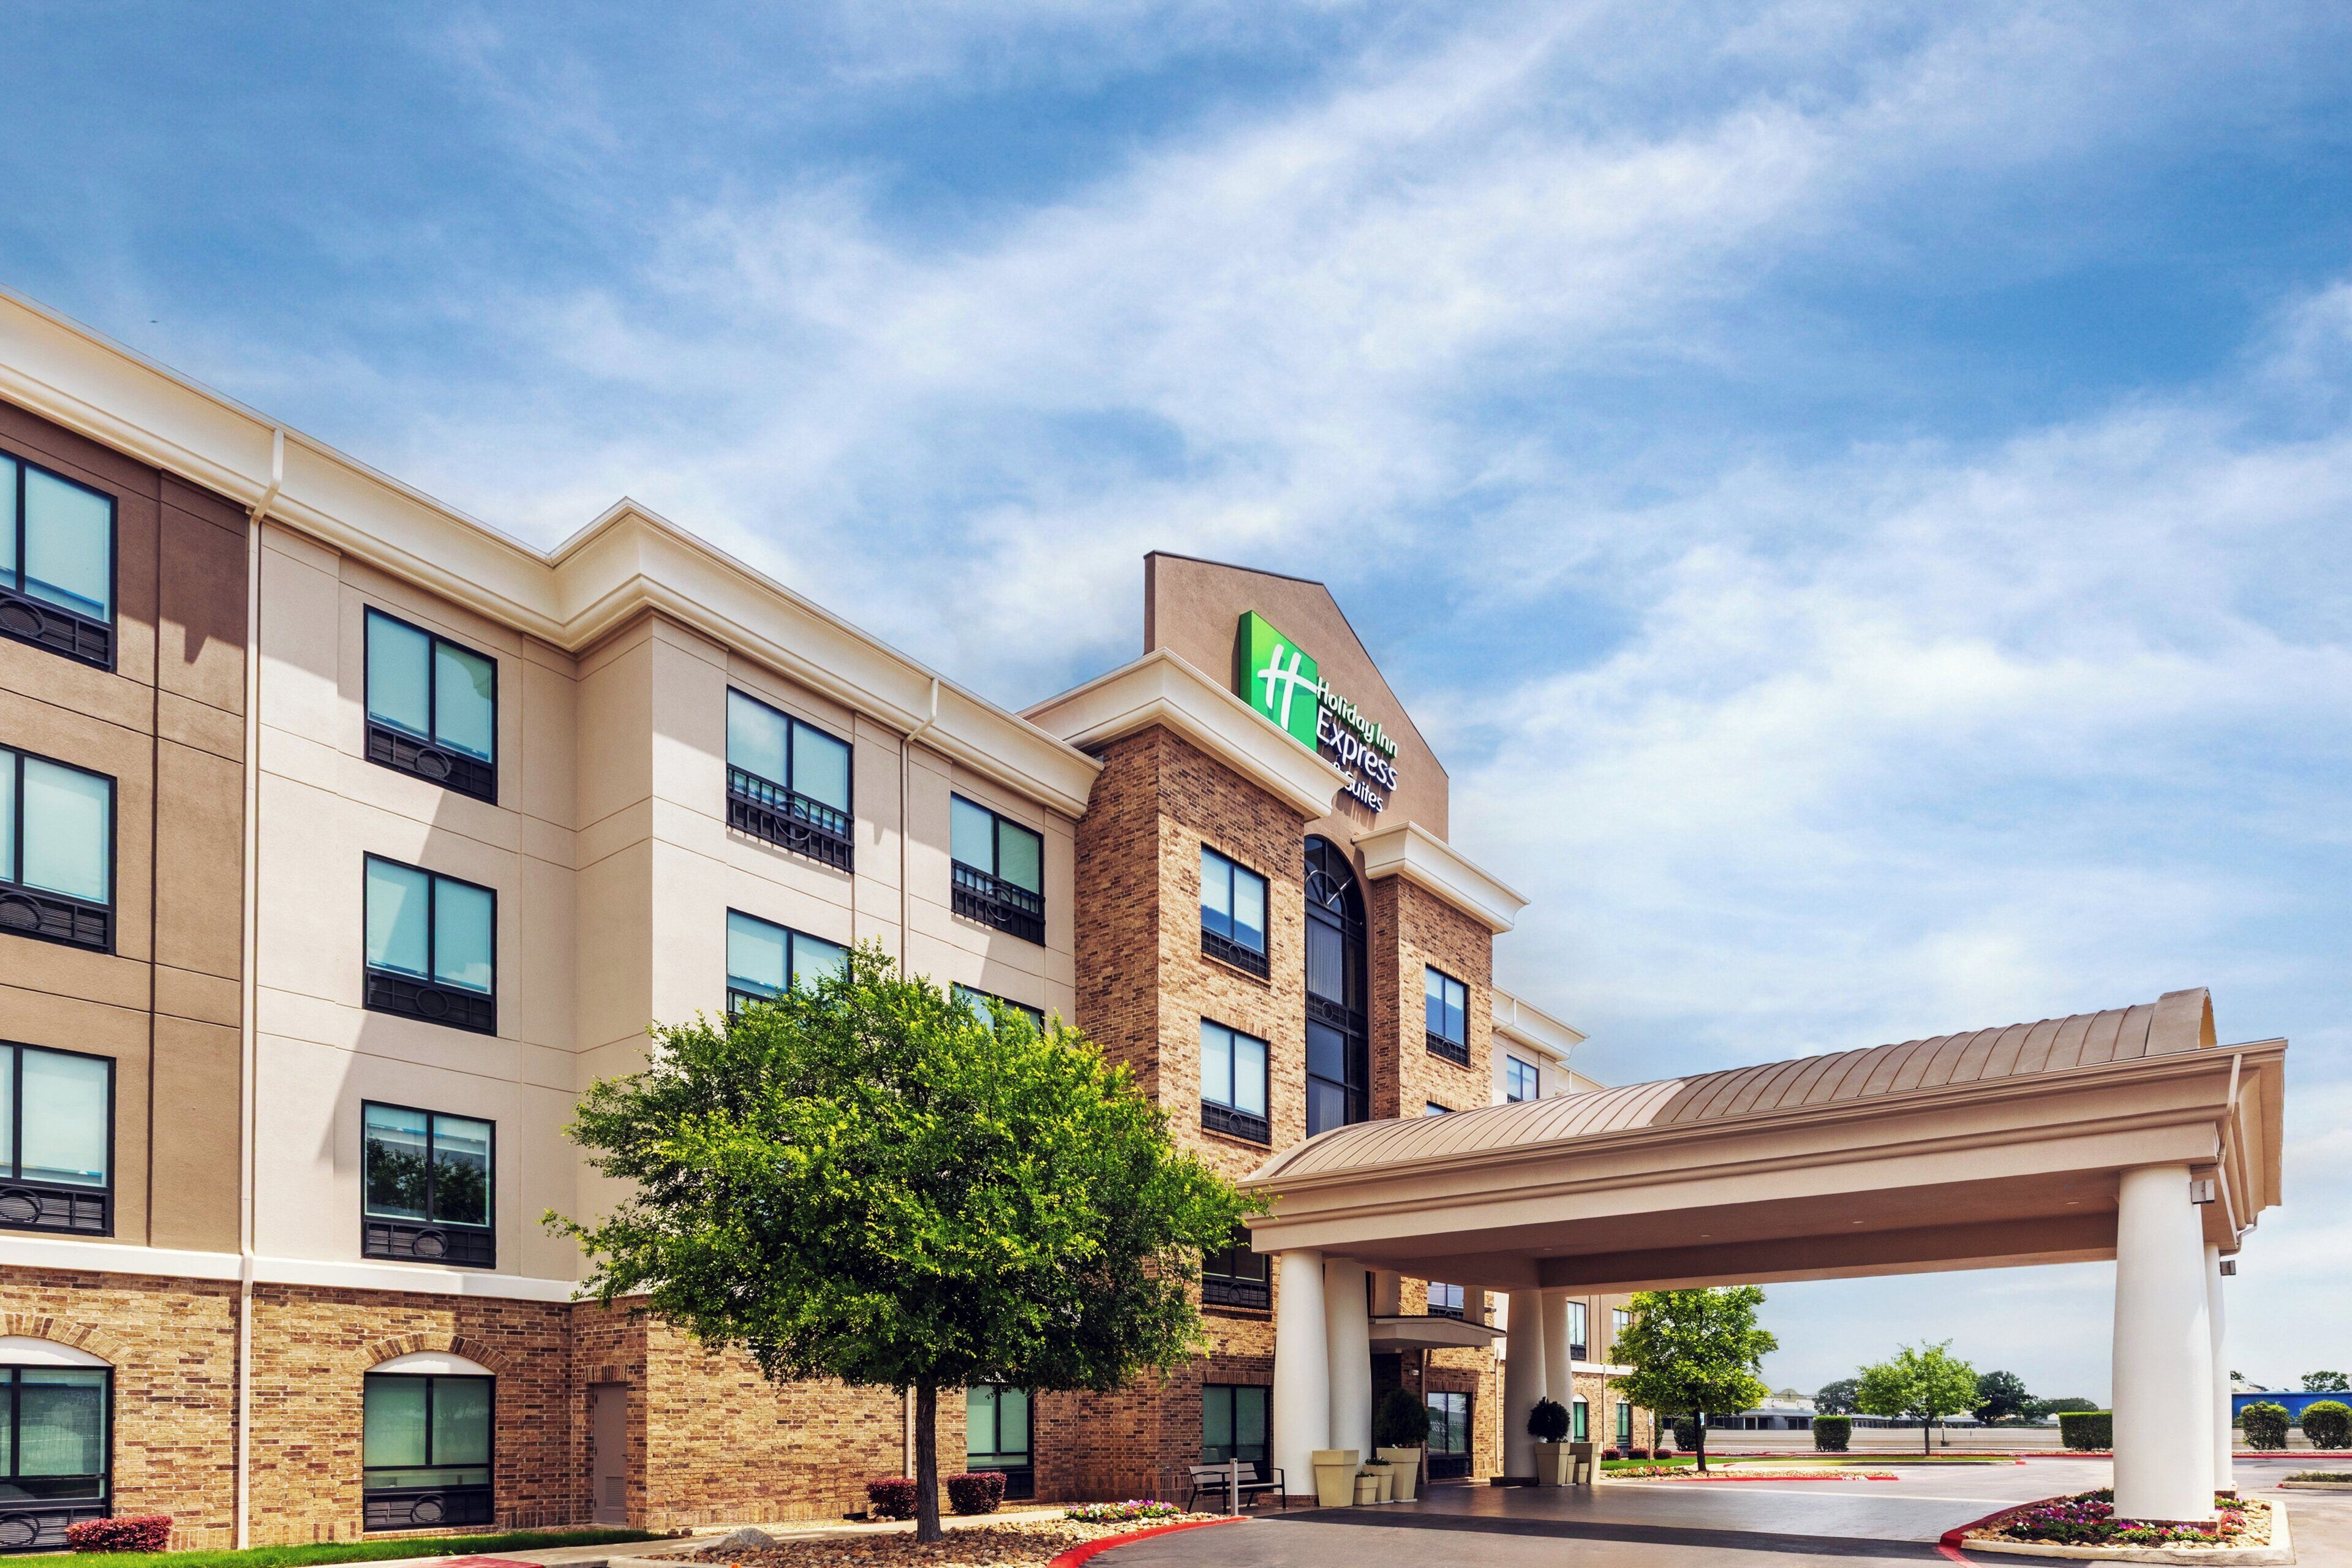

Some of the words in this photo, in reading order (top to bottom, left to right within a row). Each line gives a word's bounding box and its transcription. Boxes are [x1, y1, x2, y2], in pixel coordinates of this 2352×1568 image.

[1316, 705, 1398, 792] Express
[1317, 676, 1374, 743] Holiday
[1376, 723, 1398, 758] Inn
